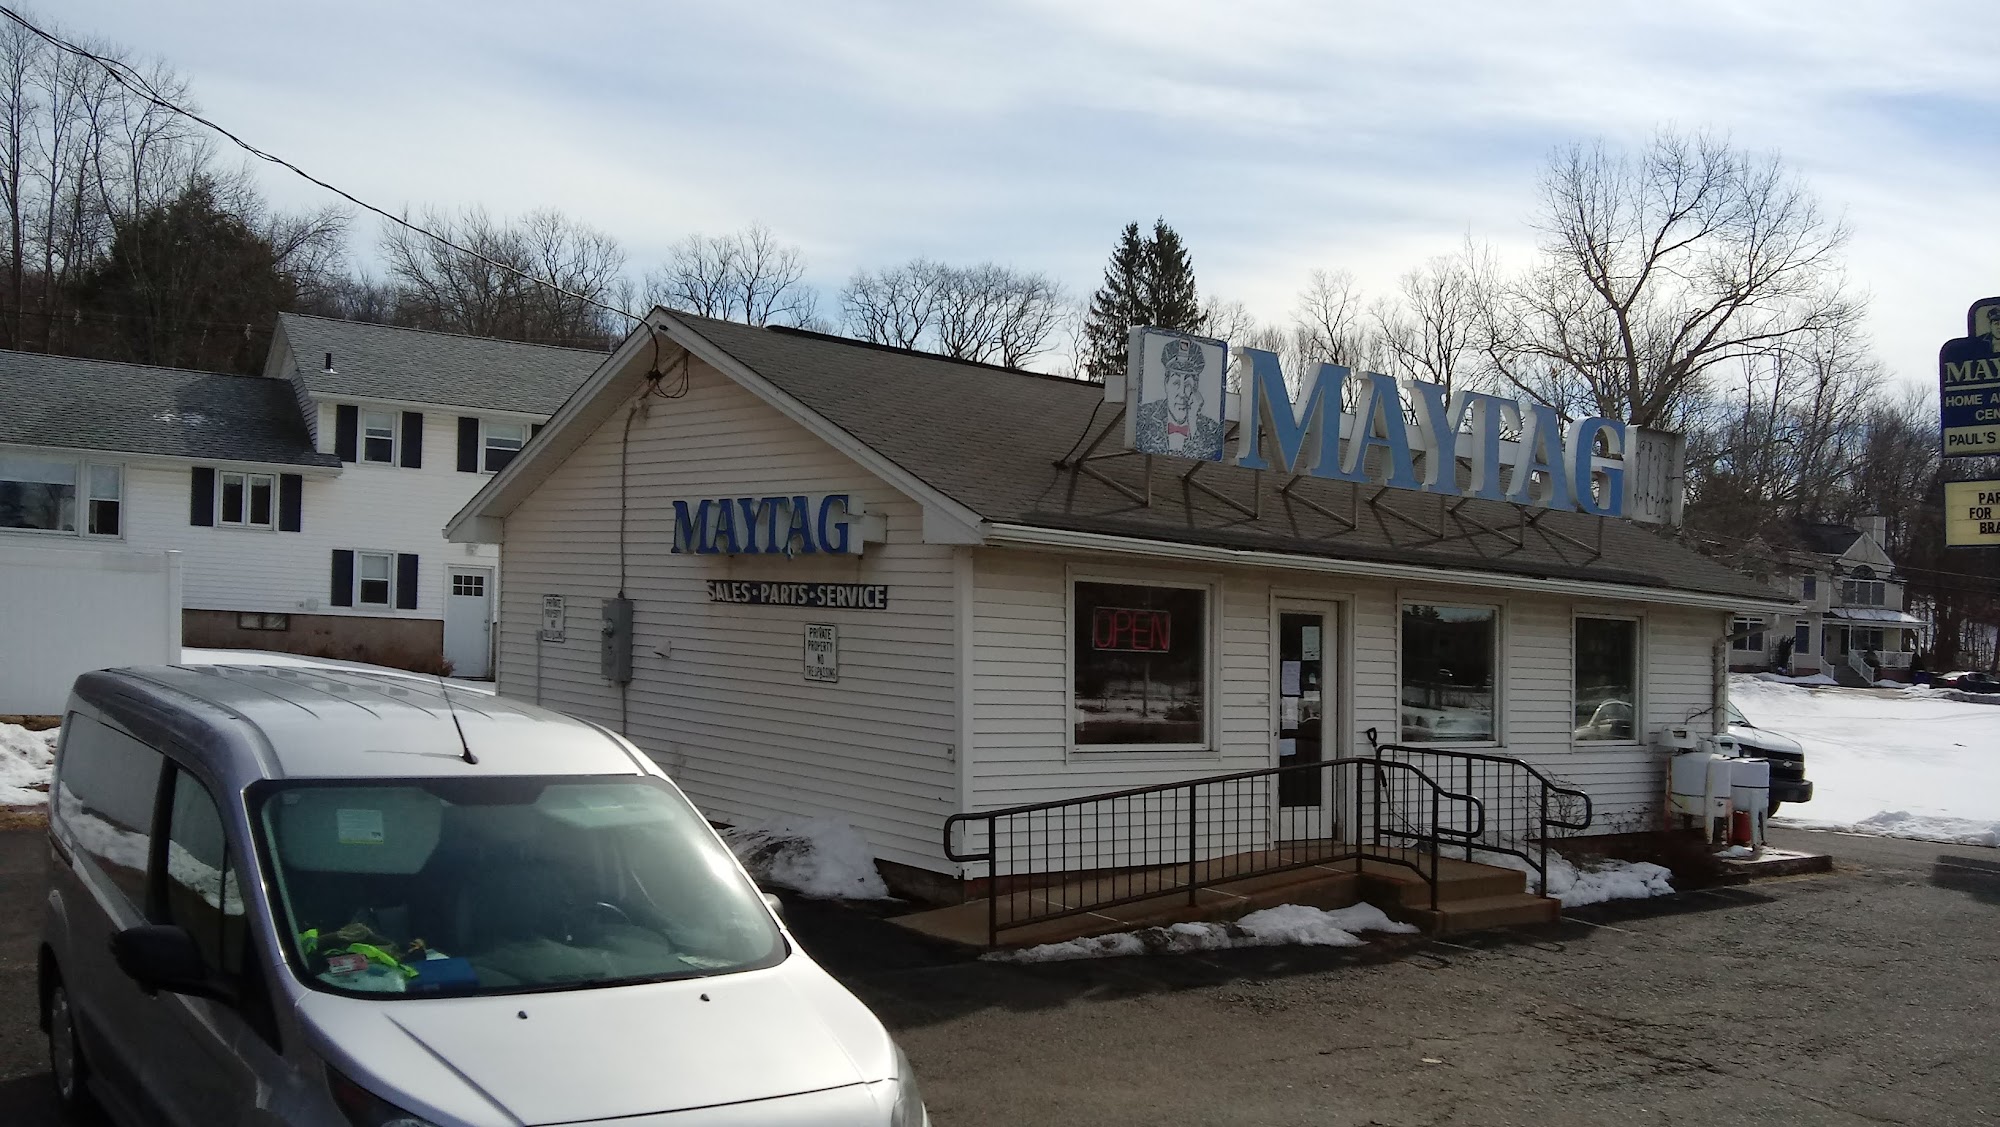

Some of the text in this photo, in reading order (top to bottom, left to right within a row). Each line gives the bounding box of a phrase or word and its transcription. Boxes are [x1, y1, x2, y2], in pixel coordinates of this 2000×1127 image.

[1945, 392, 2000, 407] HOME A
[1232, 347, 1625, 517] MAYTAG
[1949, 431, 1996, 446] PAUL'S
[1969, 507, 1991, 519] FOR
[671, 494, 849, 555] MAYTAG
[809, 627, 832, 640] PRIVATE
[1094, 609, 1170, 651] OPEN
[807, 640, 833, 653] PROPERTY
[817, 653, 824, 665] NO
[806, 665, 836, 679] TRESPASSING
